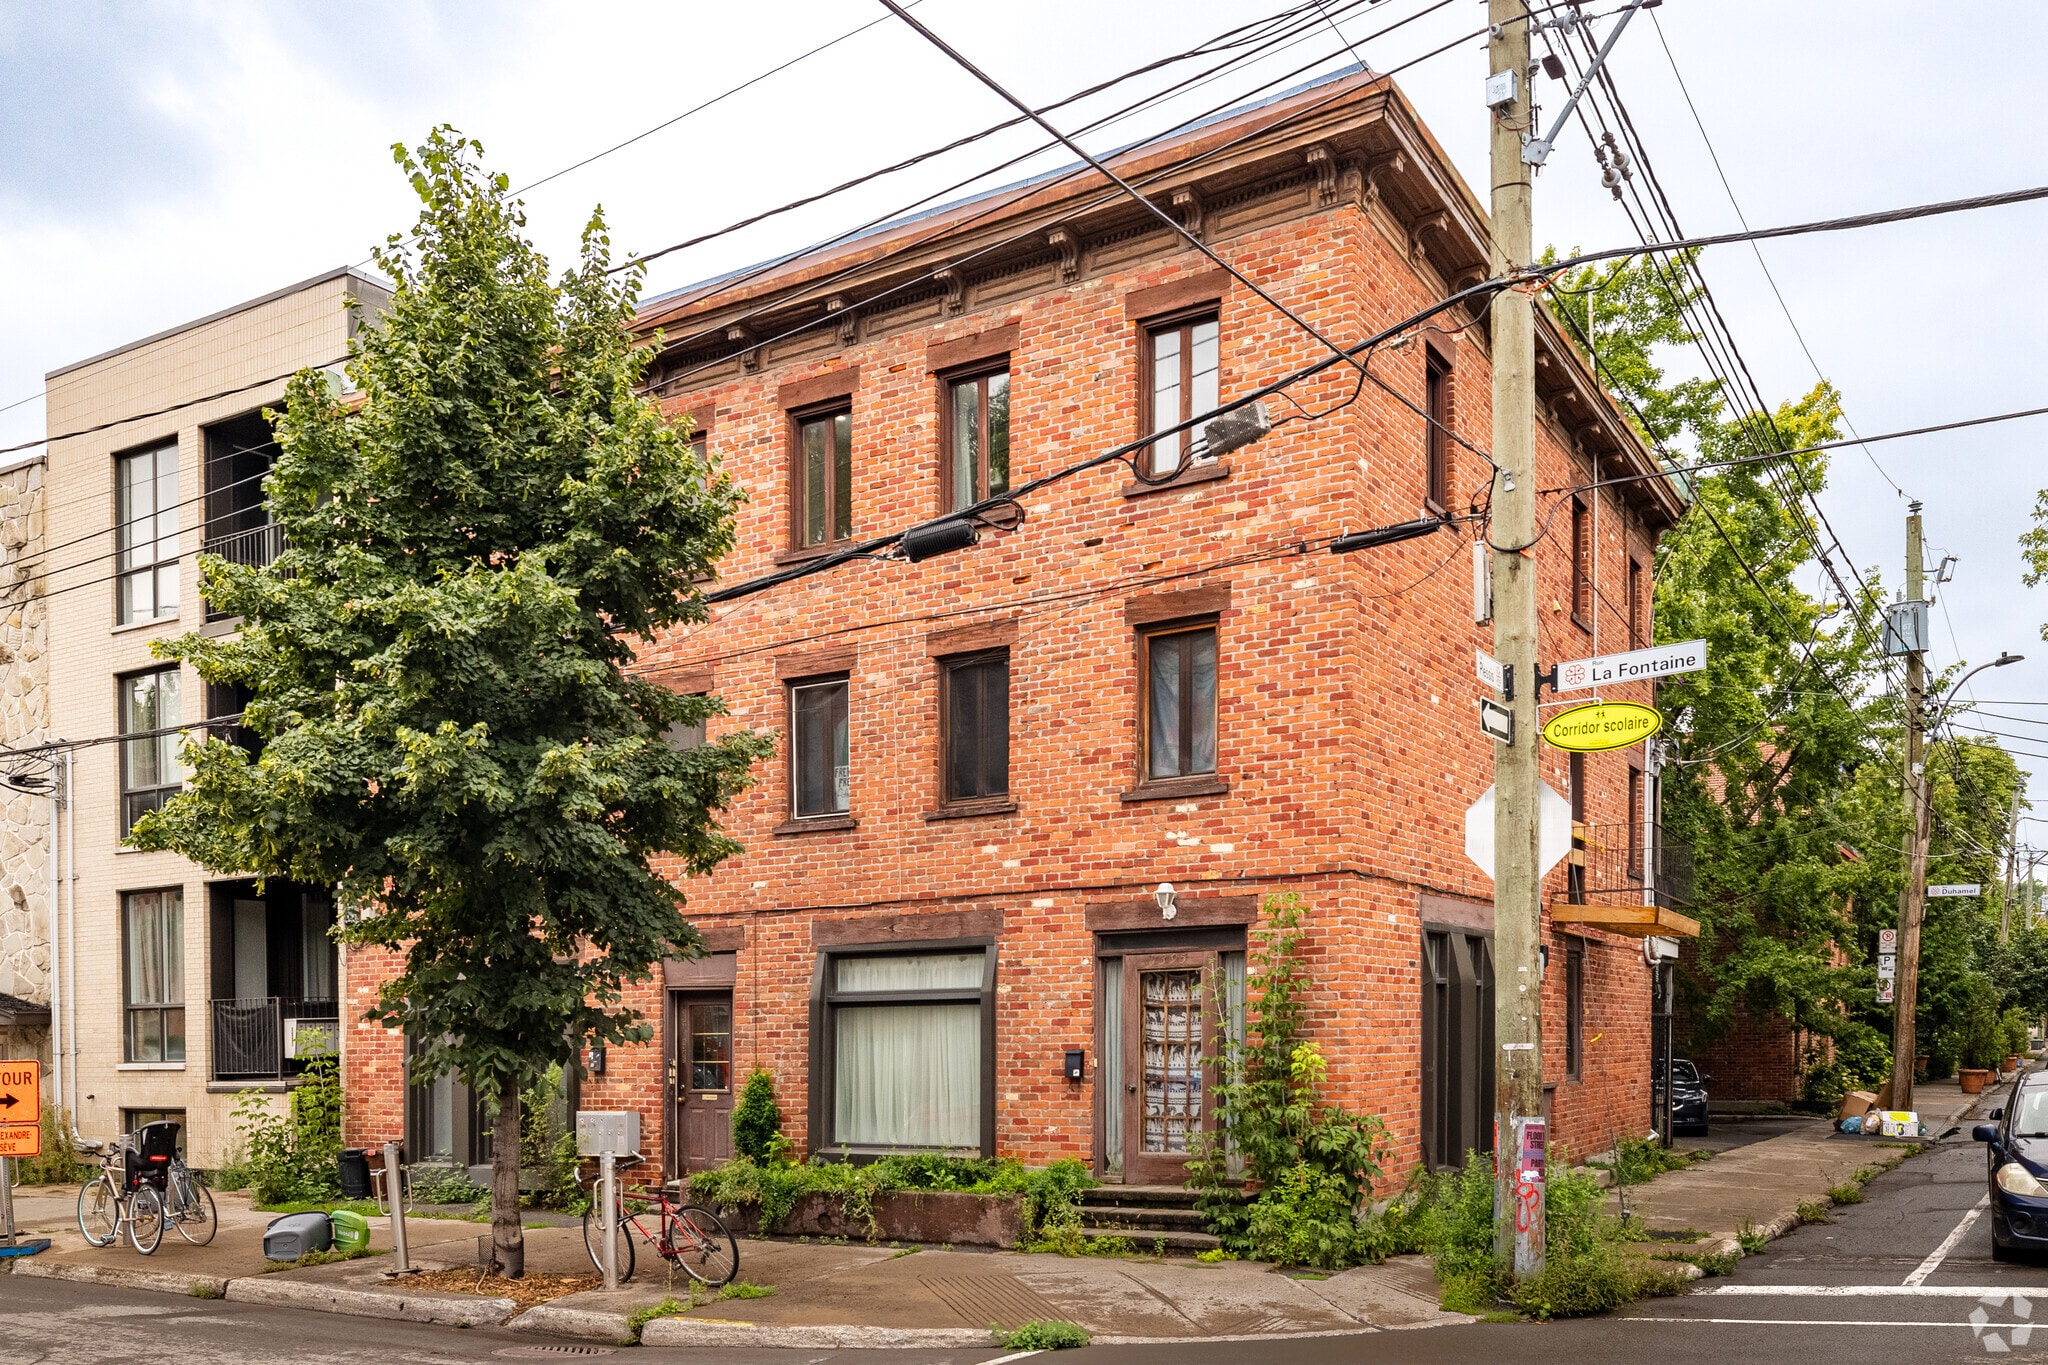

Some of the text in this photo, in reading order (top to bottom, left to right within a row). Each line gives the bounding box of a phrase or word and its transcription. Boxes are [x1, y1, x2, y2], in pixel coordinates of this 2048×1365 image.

[1592, 654, 1696, 682] La Fontaine
[1553, 716, 1649, 738] Corridor scolaire
[0, 1071, 32, 1085] OUR
